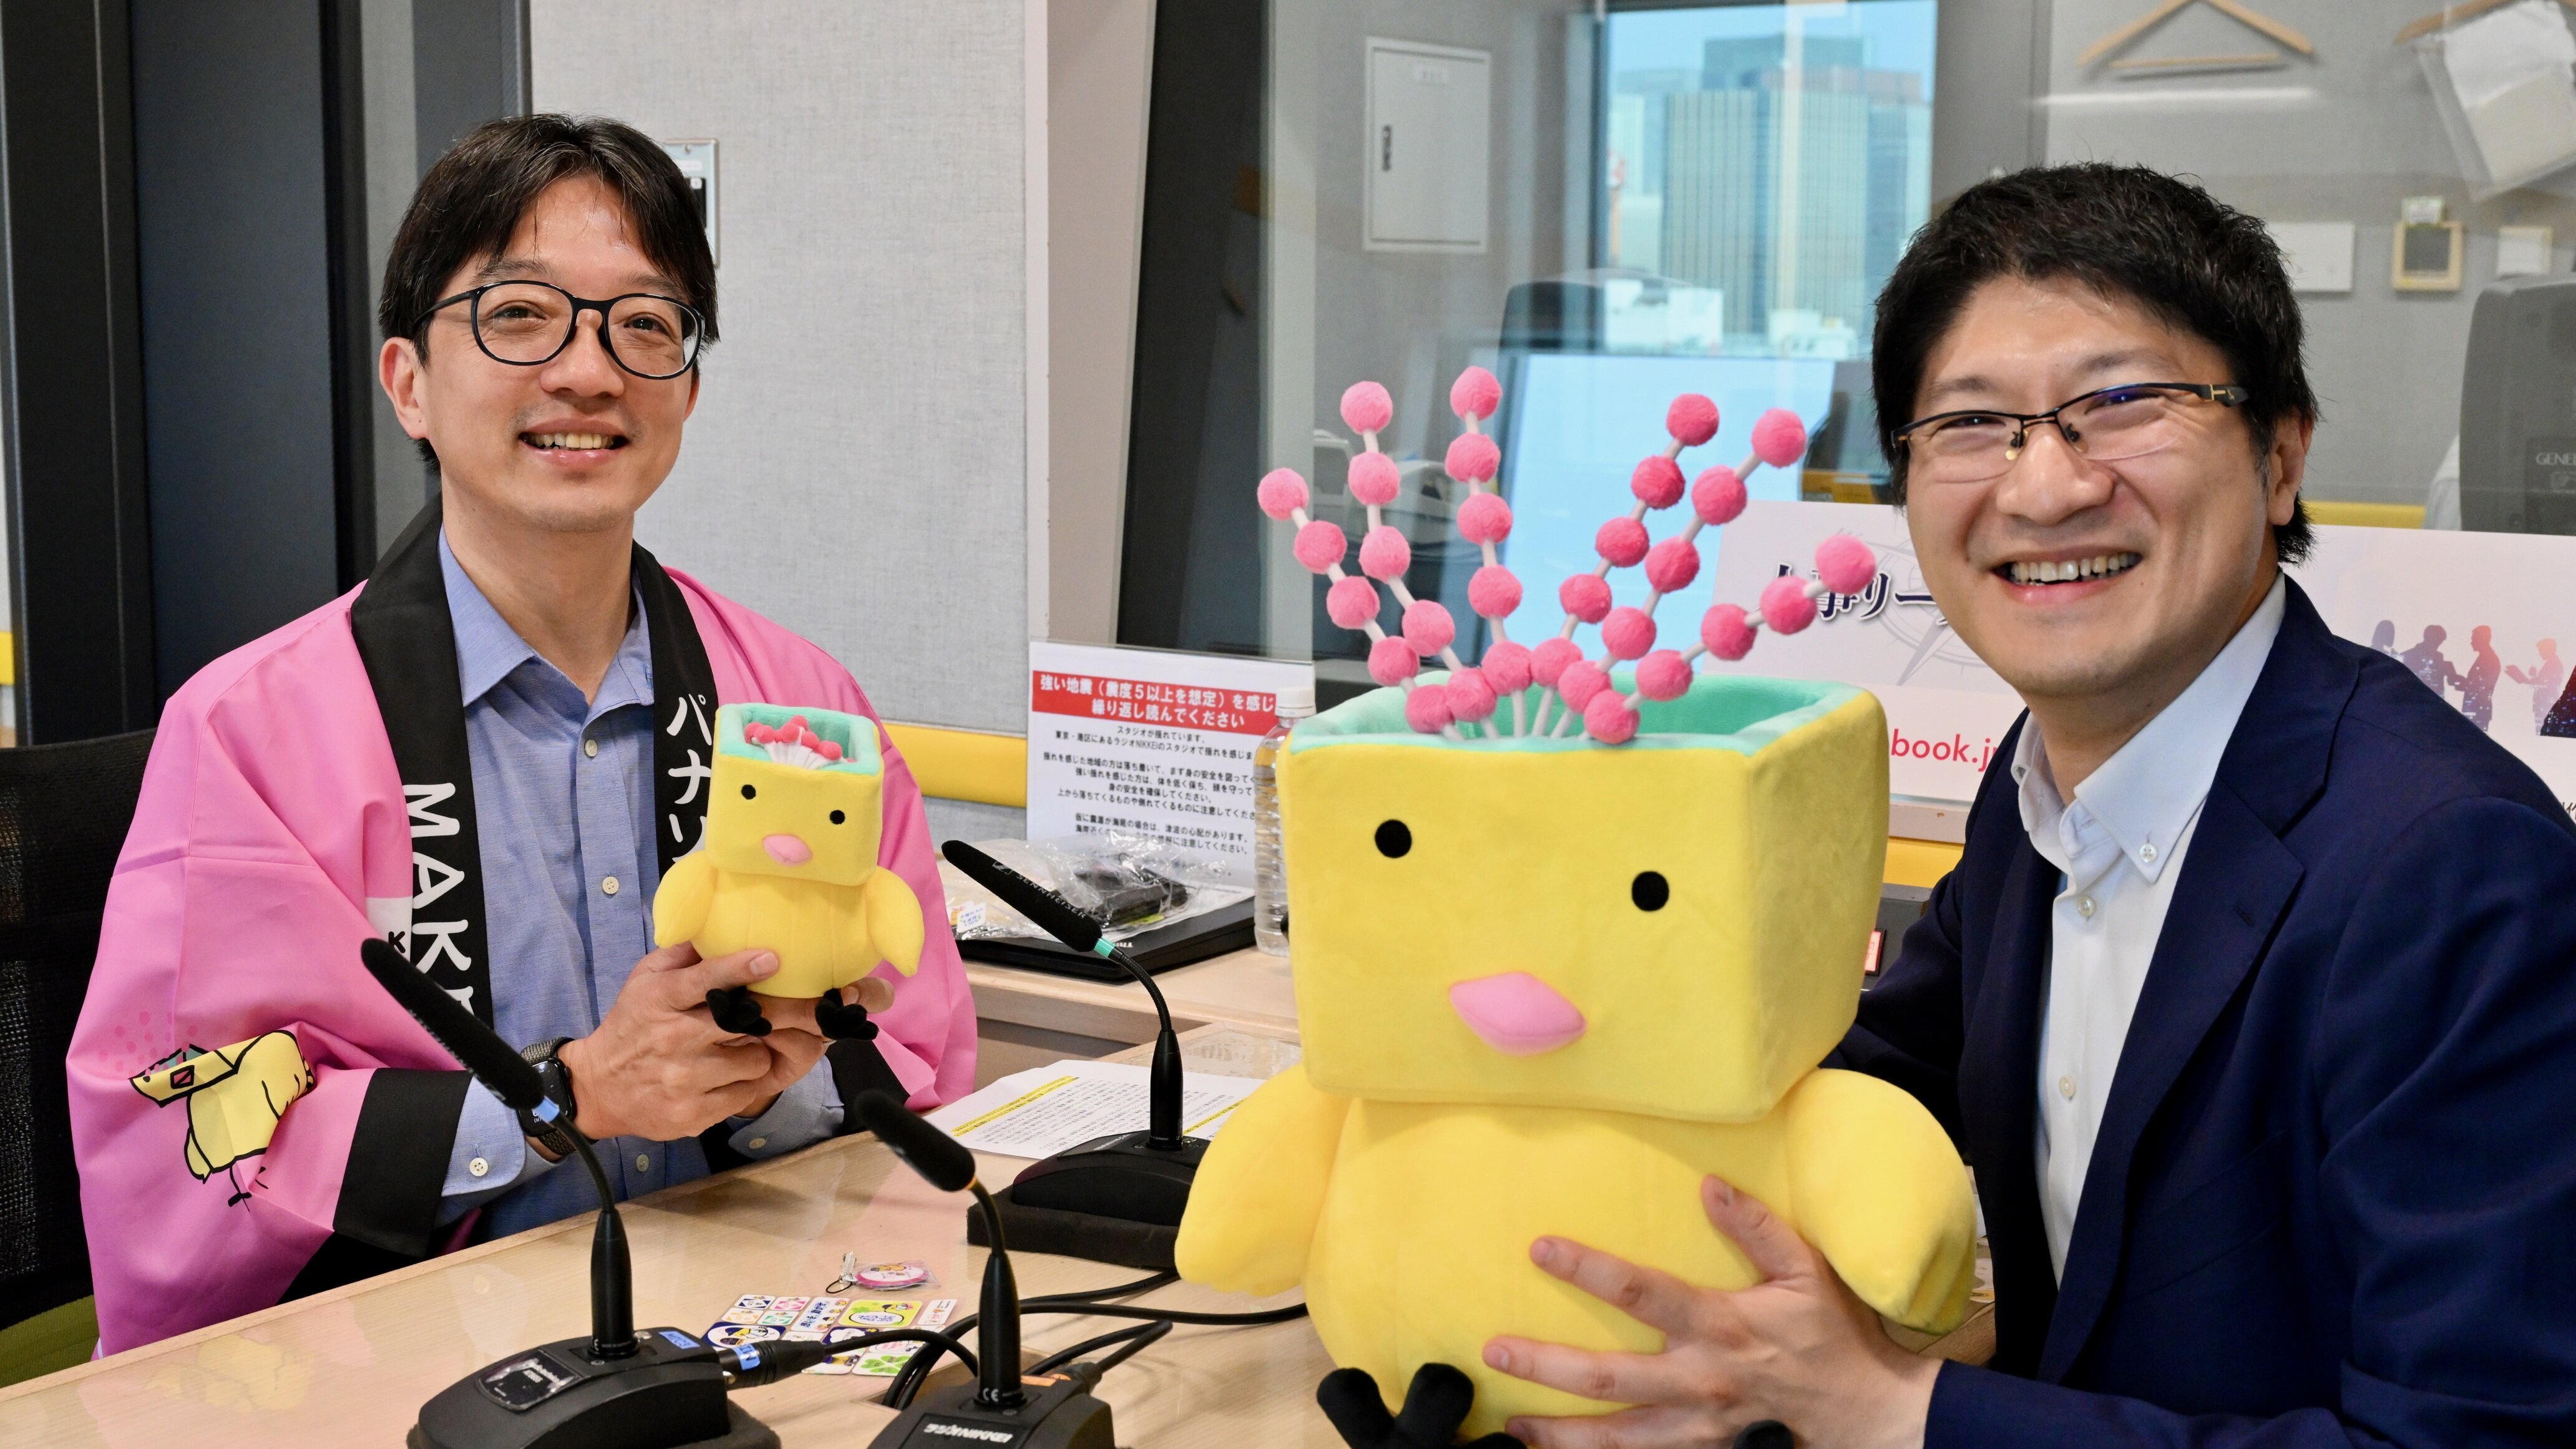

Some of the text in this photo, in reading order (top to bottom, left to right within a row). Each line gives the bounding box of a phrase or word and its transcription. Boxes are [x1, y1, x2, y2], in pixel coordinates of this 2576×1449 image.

[1092, 698, 1245, 728] 繰り返し読んでください
[1117, 725, 1204, 743] スタジオが揺れています。
[1891, 728, 1998, 772] book.j
[1109, 783, 1211, 803] 身の安全を確保してください。
[1015, 874, 1086, 919] SENNHEISER
